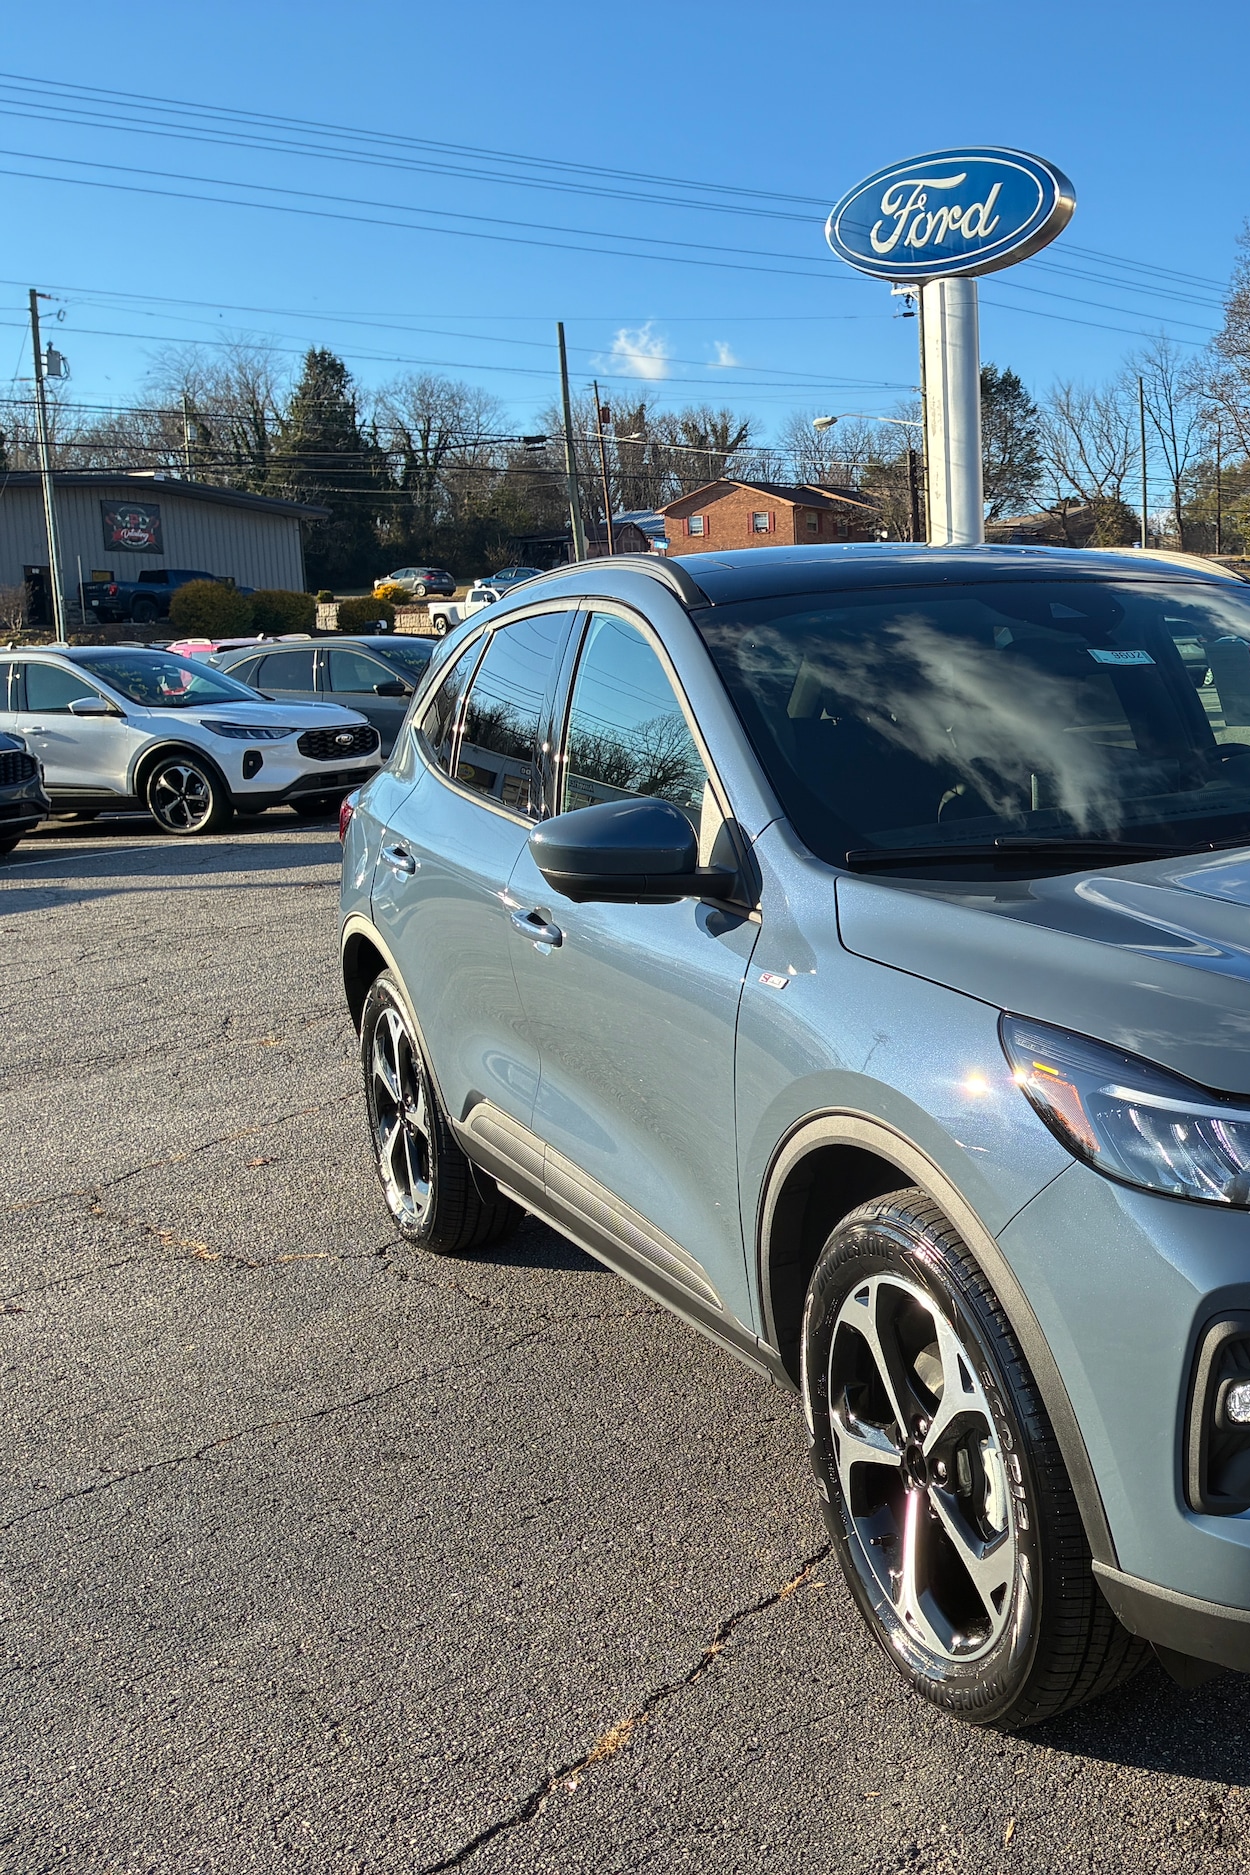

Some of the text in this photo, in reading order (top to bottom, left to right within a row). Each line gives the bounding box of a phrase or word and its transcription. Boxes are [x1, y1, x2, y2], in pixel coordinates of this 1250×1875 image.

[870, 172, 1003, 254] Ford
[1111, 651, 1144, 660] 9602
[977, 1362, 1030, 1531] ECOPIA
